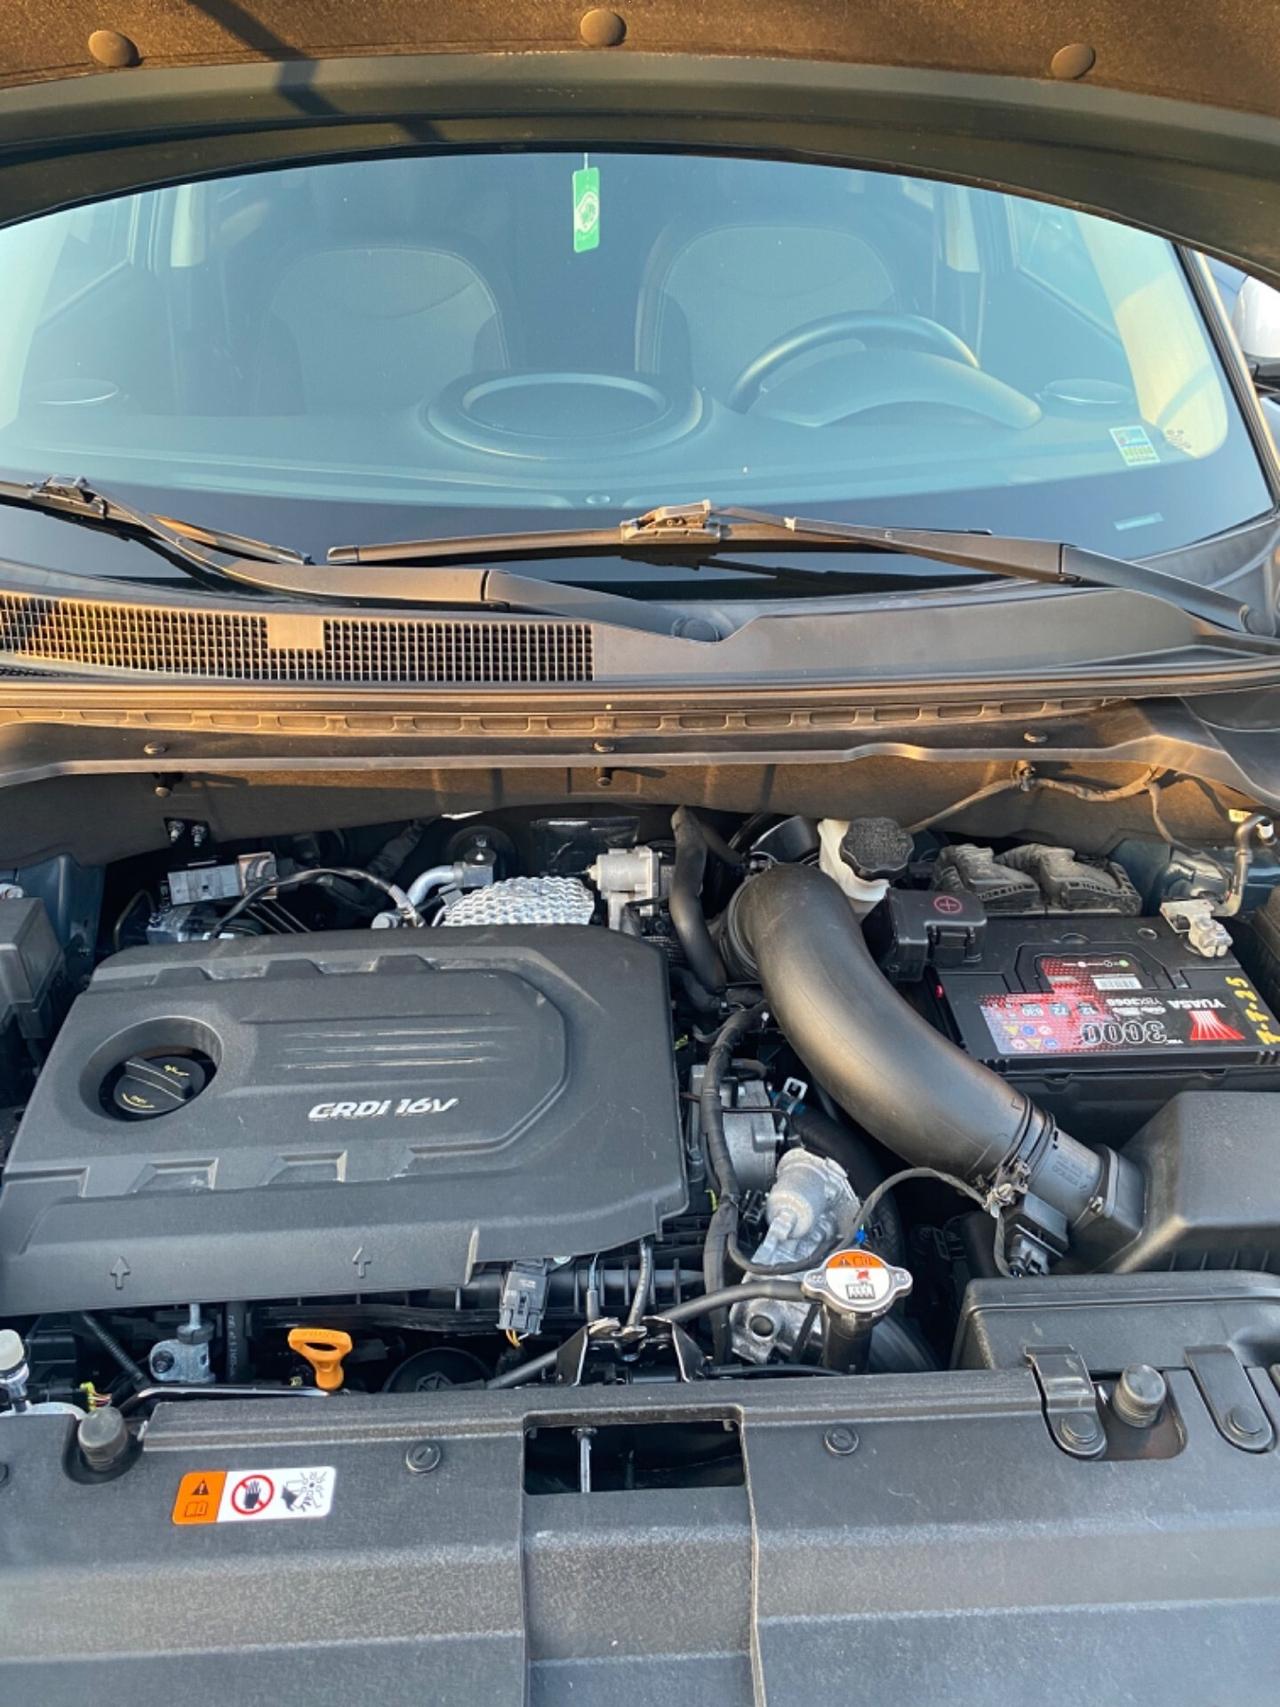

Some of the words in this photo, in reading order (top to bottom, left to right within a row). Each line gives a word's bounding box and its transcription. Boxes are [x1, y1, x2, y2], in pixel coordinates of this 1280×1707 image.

[1167, 998, 1227, 1009] YUASA
[1082, 1021, 1167, 1045] 3000
[308, 1100, 392, 1121] CRDI
[395, 1097, 460, 1117] 16V
